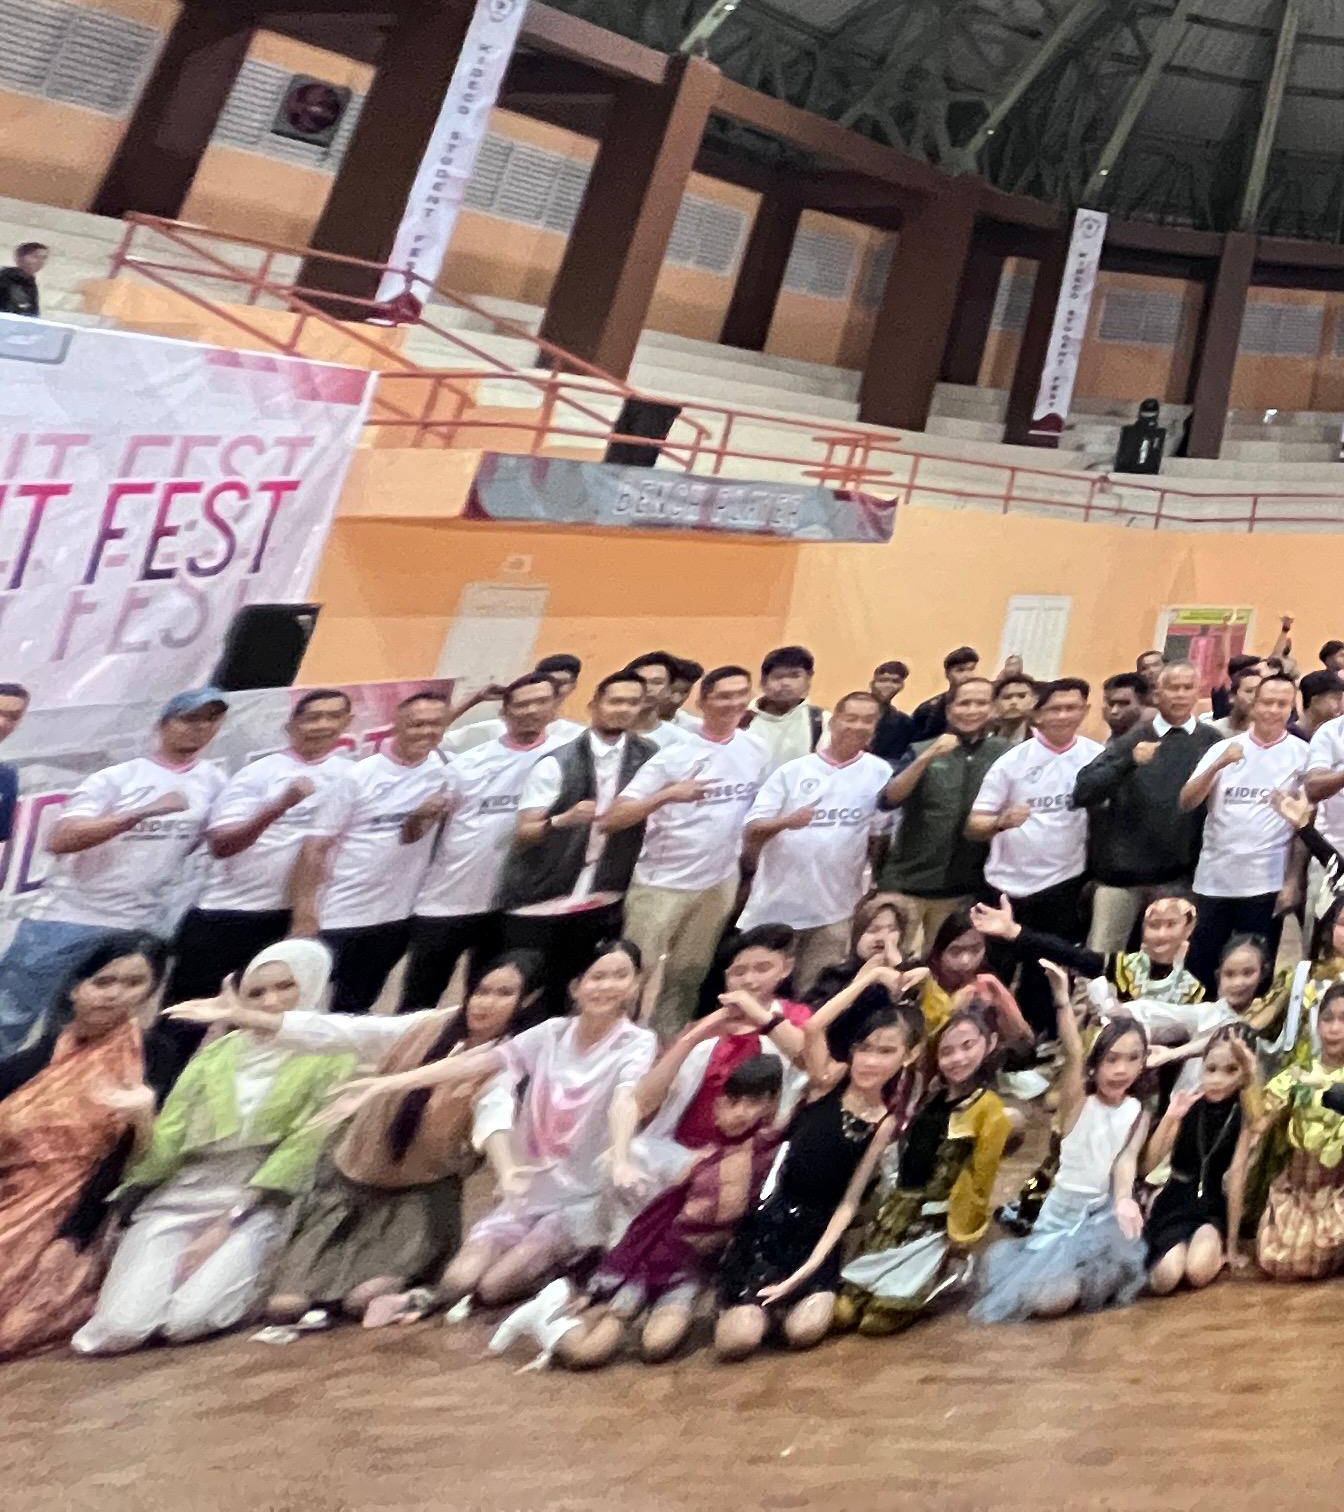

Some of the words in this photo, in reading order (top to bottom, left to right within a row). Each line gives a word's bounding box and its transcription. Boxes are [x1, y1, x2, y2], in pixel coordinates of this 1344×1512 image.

[81, 480, 304, 586] FEST
[1225, 787, 1271, 799] KIDEC
[815, 807, 864, 820] DECO
